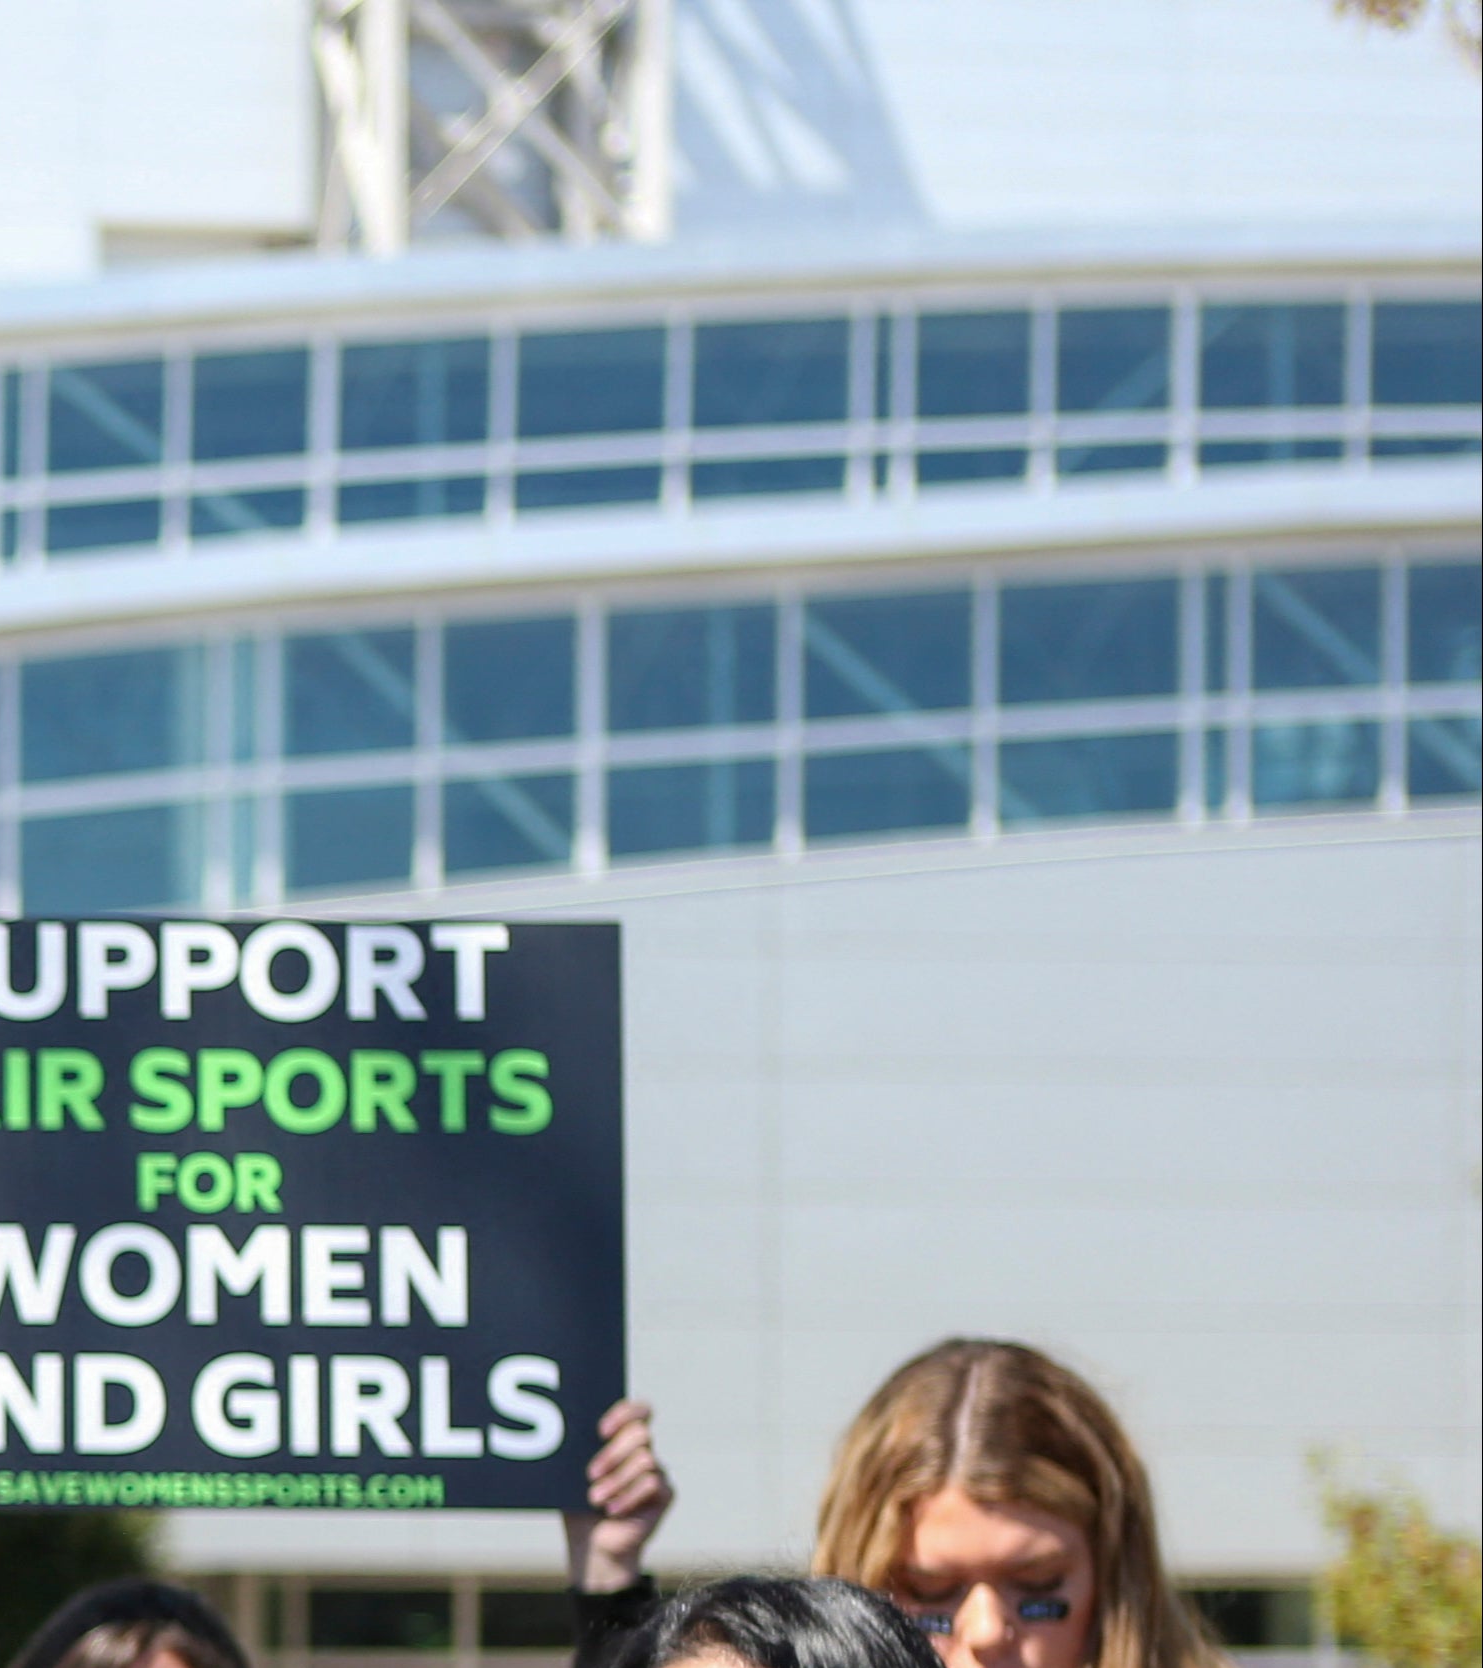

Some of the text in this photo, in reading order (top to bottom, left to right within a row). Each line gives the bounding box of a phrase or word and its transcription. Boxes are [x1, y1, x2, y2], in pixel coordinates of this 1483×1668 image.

[129, 1047, 553, 1134] SPORTS
[136, 1152, 283, 1214] FOR
[193, 1354, 563, 1457] GIRLS
